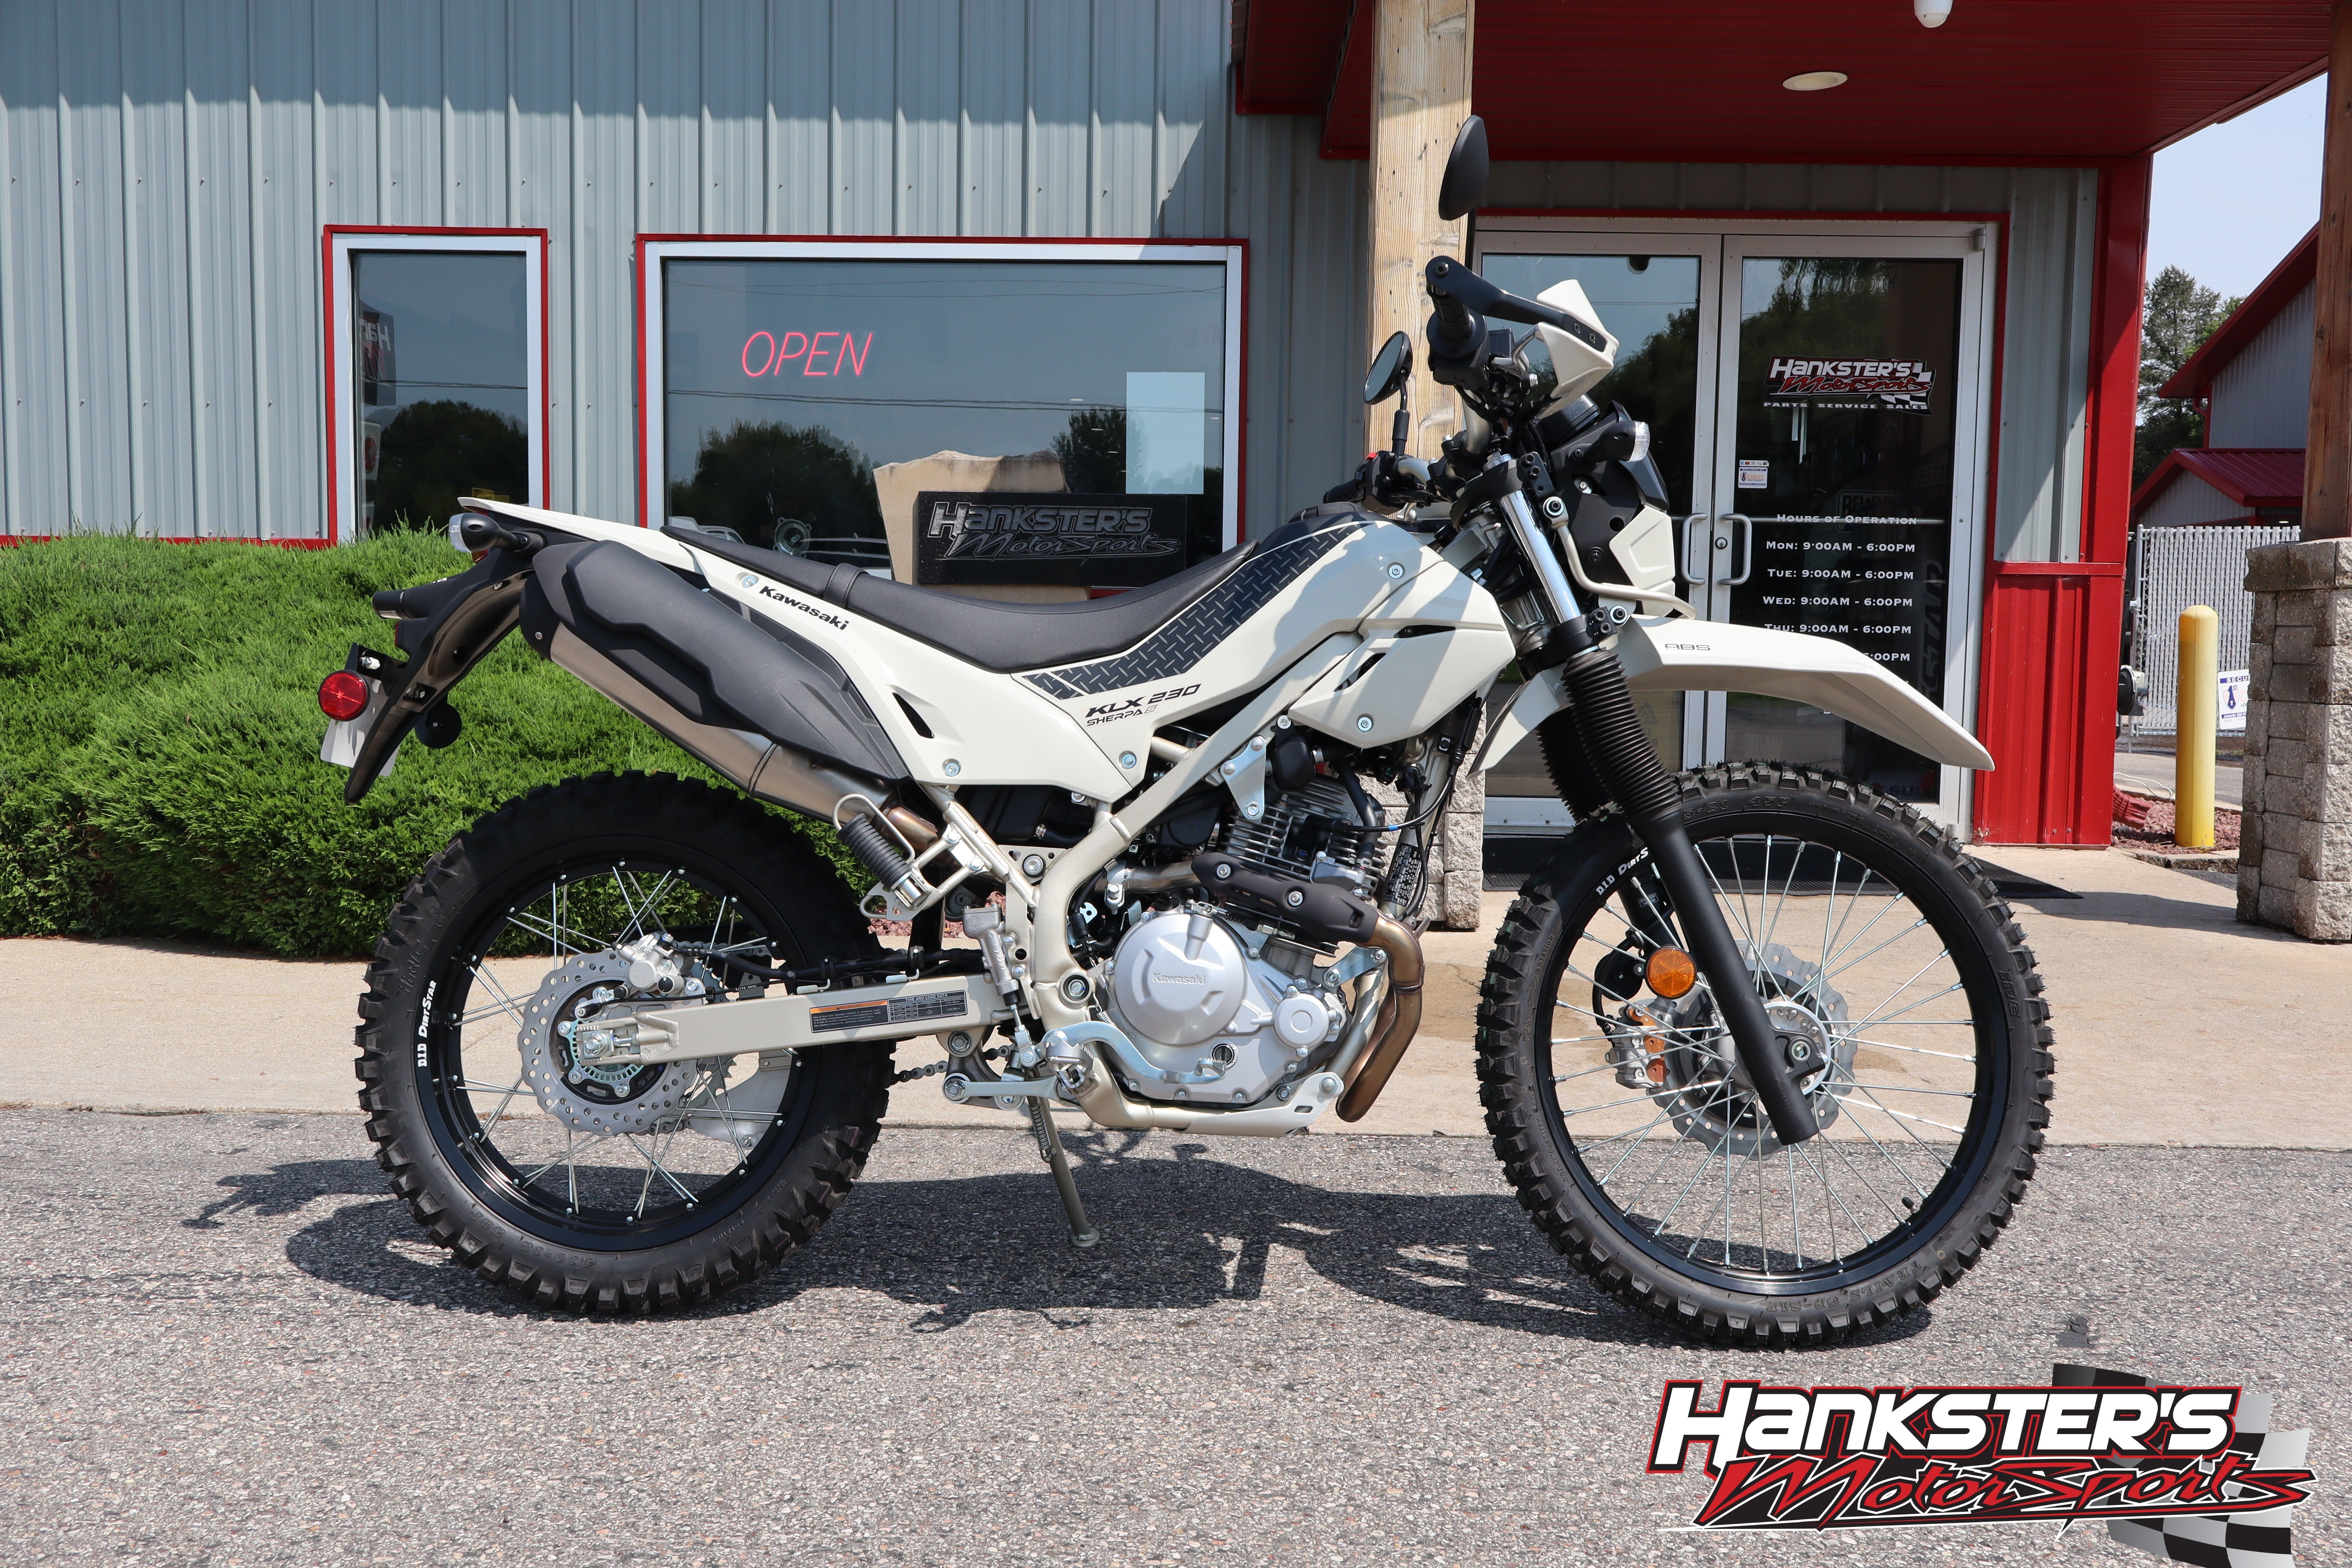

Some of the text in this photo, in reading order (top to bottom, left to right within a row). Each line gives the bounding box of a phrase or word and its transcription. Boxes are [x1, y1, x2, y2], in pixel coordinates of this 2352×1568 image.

[742, 331, 873, 377] OPEN
[1777, 514, 1819, 523] HOURS
[1845, 515, 1917, 524] OPERATION
[1766, 541, 1798, 550] MON:
[1866, 543, 1915, 552] 6:00PM
[1768, 569, 1797, 577] TUE:
[1802, 570, 1851, 578] 9:00AM
[1865, 571, 1914, 580] 6:00PM
[759, 586, 849, 631] Kawasaki
[1763, 596, 1795, 604] WED:
[1800, 597, 1849, 606] 9:00AM
[1864, 598, 1913, 607] 6:00PM
[1799, 624, 1849, 633] 9:00AM
[1863, 625, 1911, 634] 6:00PM
[1665, 643, 1710, 651] ABS
[1084, 683, 1203, 718] KLX 230
[1085, 708, 1143, 727] SHERPA
[1537, 935, 1554, 972] ROTATION
[1151, 972, 1206, 986] Kawasaki
[417, 1043, 427, 1067] D.I.D
[434, 1167, 457, 1194] TUBELESS
